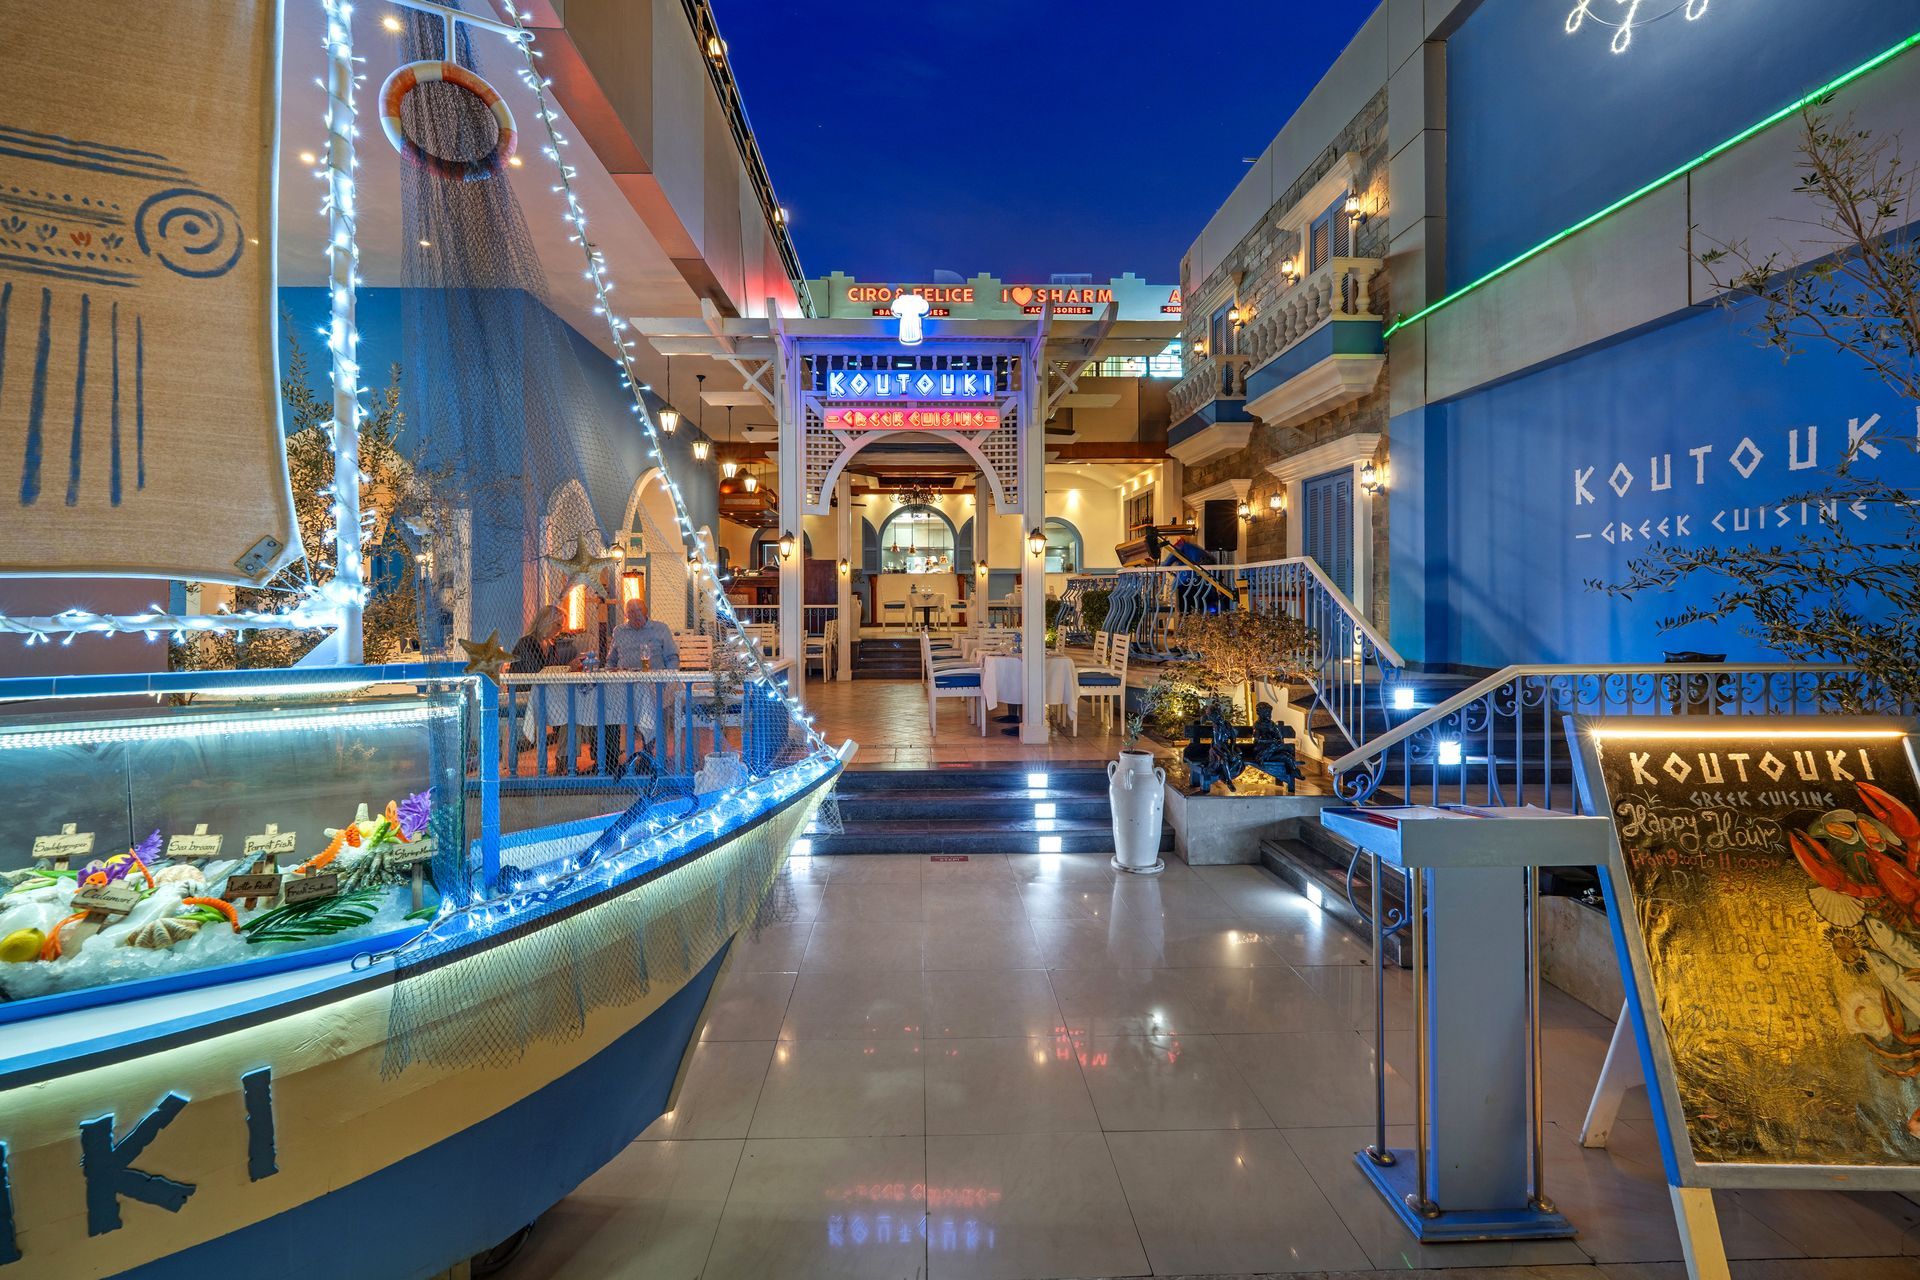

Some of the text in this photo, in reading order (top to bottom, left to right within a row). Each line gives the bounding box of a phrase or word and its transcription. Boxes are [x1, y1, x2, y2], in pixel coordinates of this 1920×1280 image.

[847, 287, 892, 302] CIRO
[1036, 289, 1113, 303] SHARM
[829, 371, 992, 397] KOUTOUKI
[842, 410, 984, 427] GREEK CUISINE
[1601, 496, 1868, 544] GREEK CUISINE
[1629, 749, 1875, 785] KOUTOUKI
[1689, 790, 1836, 807] GREEK CUISINE
[1617, 803, 1777, 851] Happy Hour
[169, 840, 188, 852] Sea
